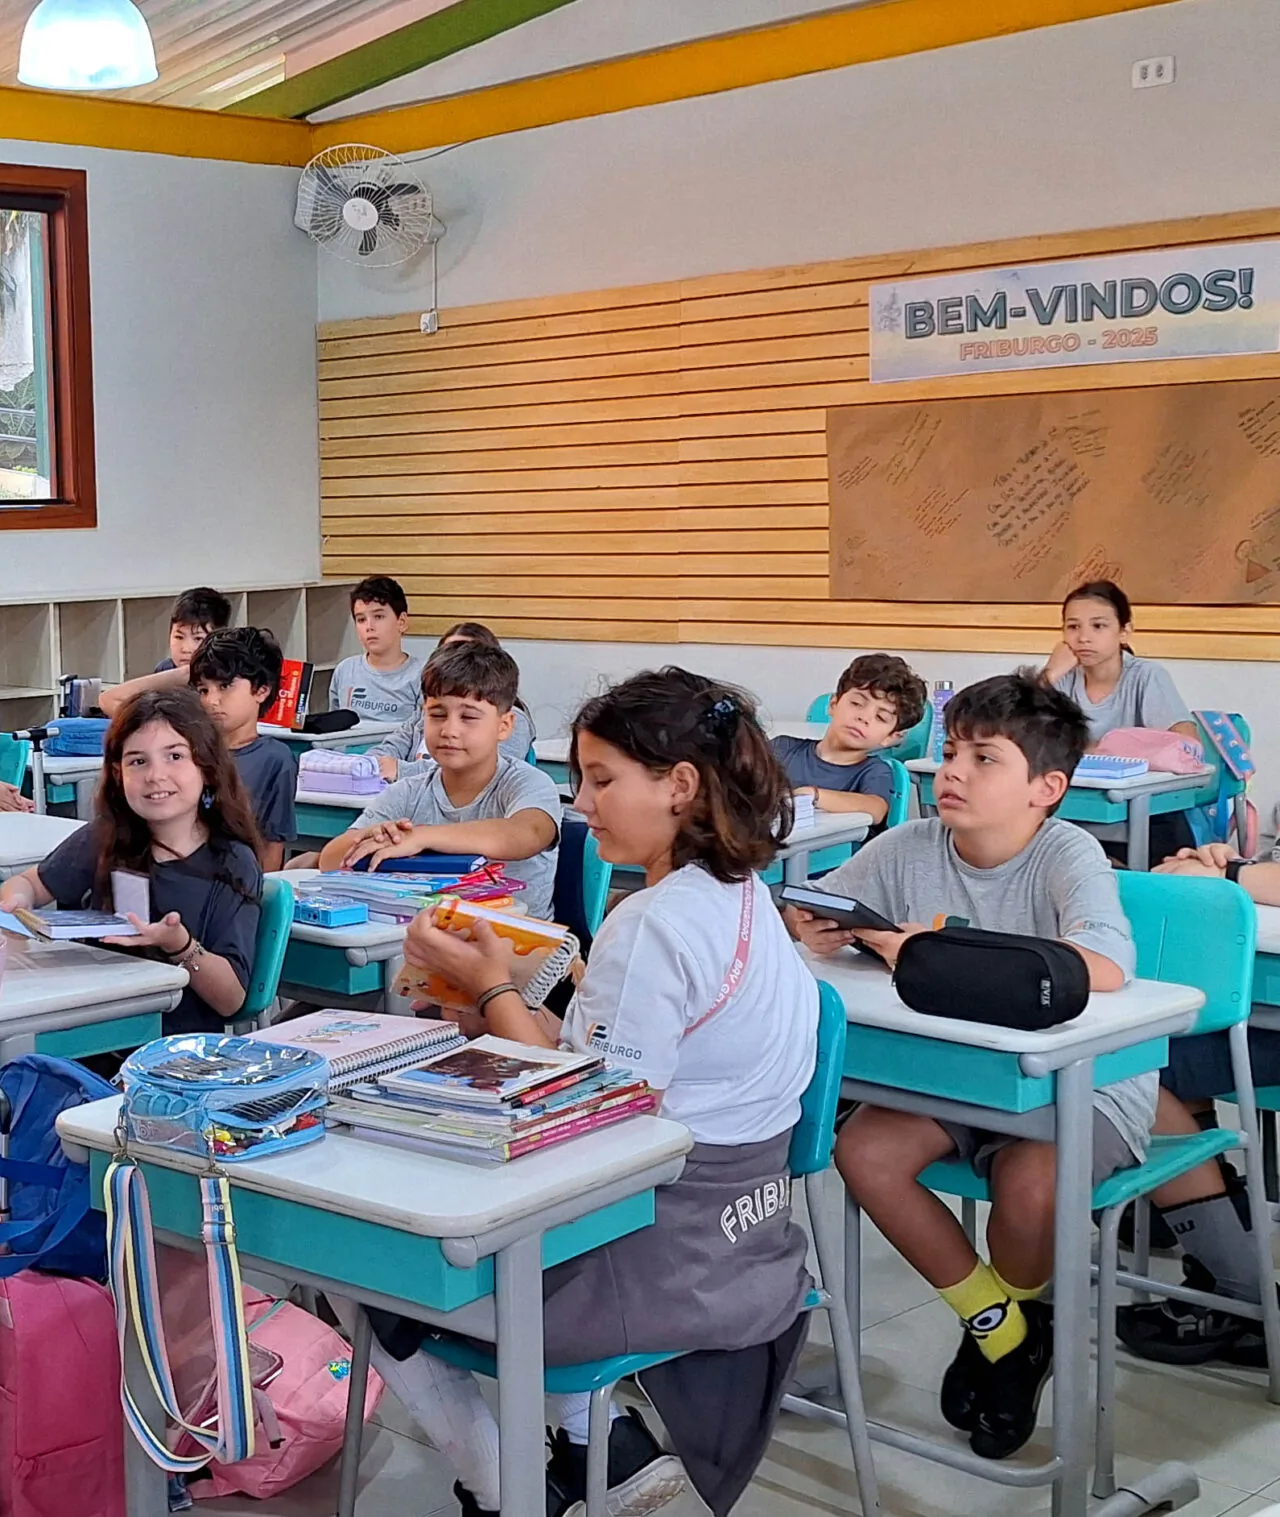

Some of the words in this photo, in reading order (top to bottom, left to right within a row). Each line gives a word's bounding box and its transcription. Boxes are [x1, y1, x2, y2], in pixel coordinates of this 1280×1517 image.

[905, 267, 1255, 340] BEM-VINDOS!
[960, 332, 1081, 361] FRIBURGO
[1102, 326, 1159, 349] 2025
[351, 698, 398, 713] FRIBURGO
[589, 1037, 642, 1060] FRIBURGO
